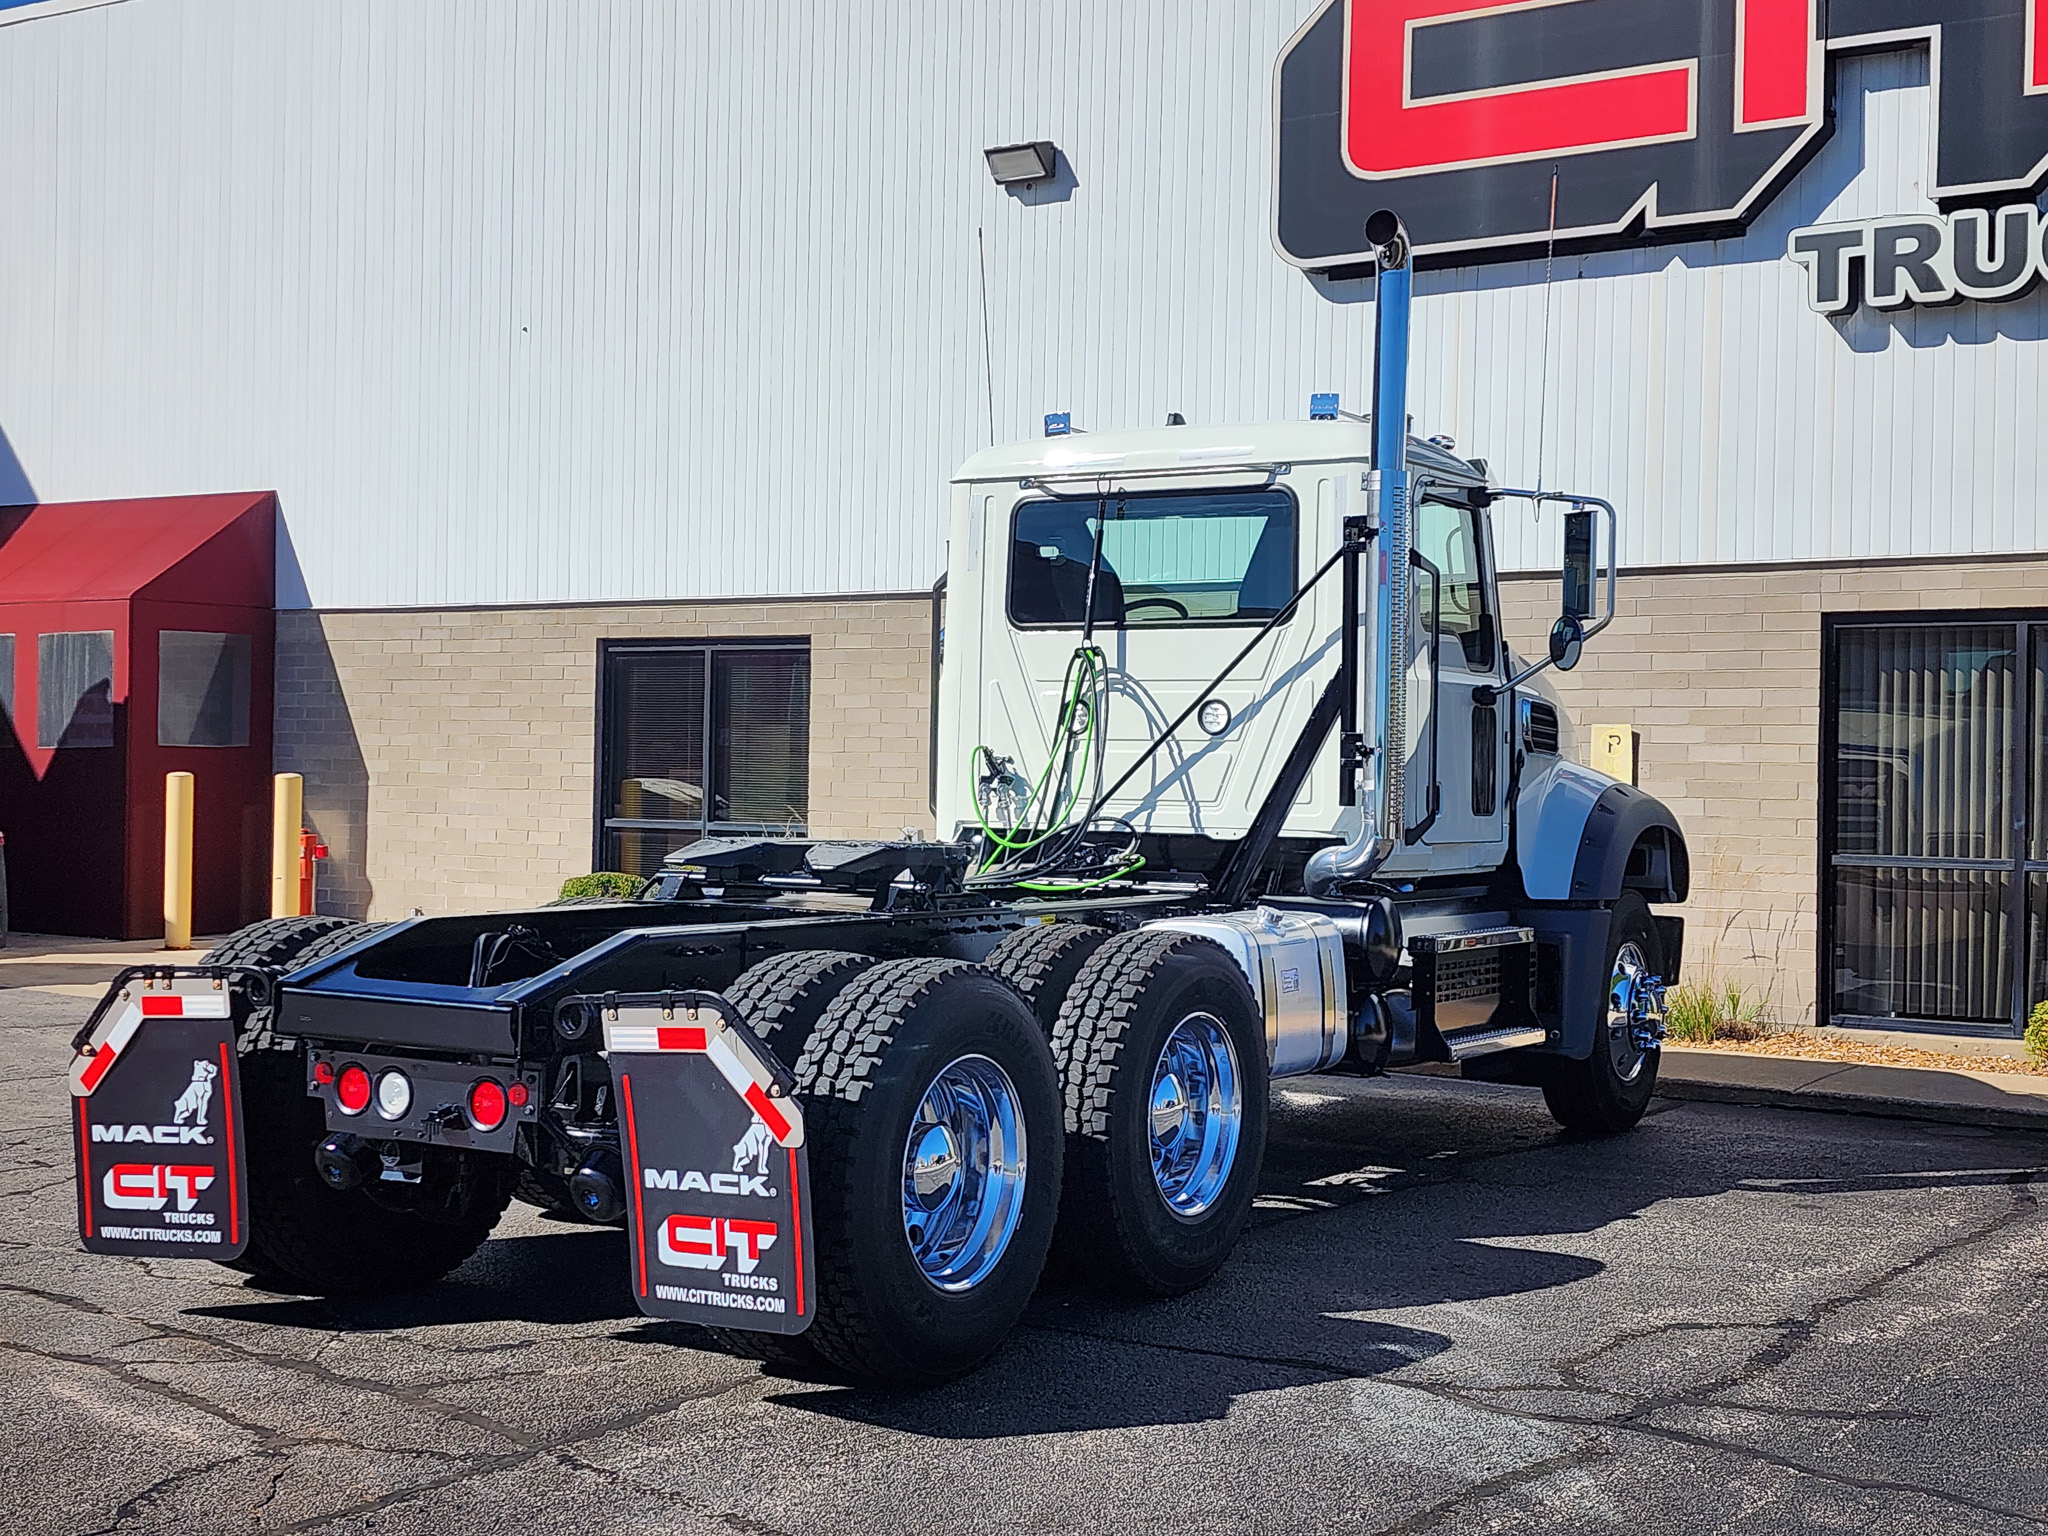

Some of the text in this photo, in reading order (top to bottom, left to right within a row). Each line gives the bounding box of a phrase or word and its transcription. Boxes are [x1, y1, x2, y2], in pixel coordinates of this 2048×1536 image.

[1791, 206, 2048, 307] TRU
[103, 1164, 215, 1211] CIT
[163, 1212, 215, 1225] TRUCKS
[100, 1226, 221, 1243] WWW.CITTRUCKS.COM
[657, 1214, 778, 1273] CIT
[721, 1273, 778, 1291] TRUCKS
[655, 1285, 785, 1313] WWW.CITTRUCKS.COM
